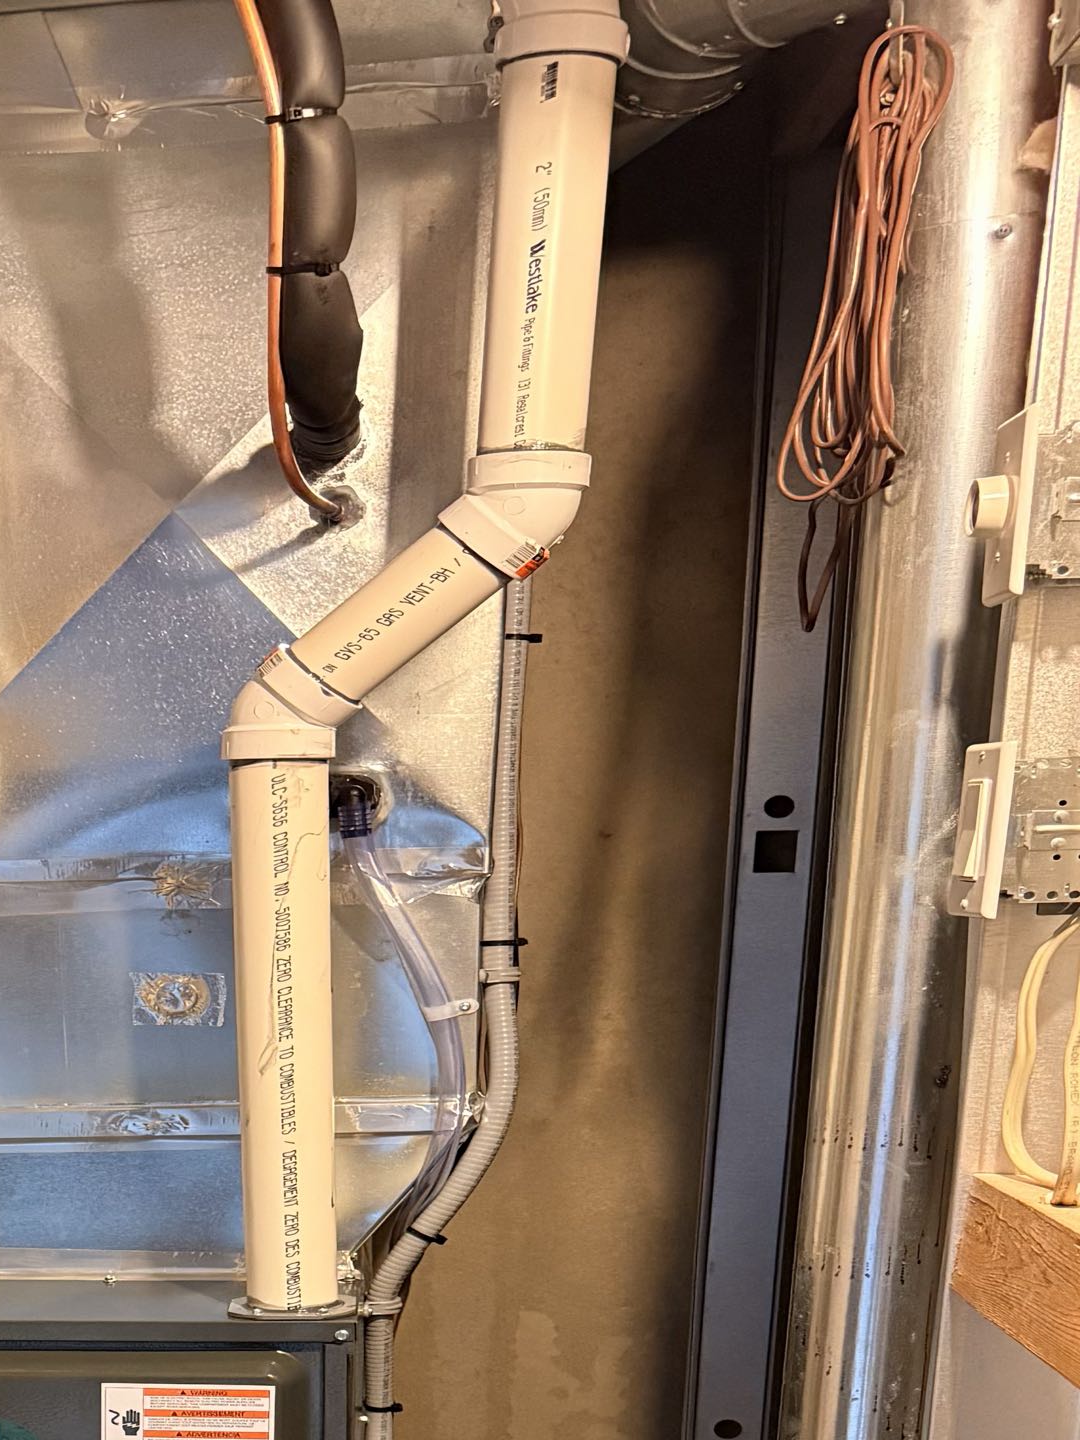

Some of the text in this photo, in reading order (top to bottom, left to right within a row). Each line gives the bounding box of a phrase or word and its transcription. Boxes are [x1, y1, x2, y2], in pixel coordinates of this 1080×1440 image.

[525, 187, 551, 314] (50mm) Westlake
[334, 567, 456, 661] GVS-65 GAS VENT-BH
[270, 772, 288, 827] ULC-S636
[273, 831, 289, 879] CONTROL
[274, 906, 292, 952] 5007586
[276, 955, 292, 983] ZERO
[277, 986, 294, 1043] CLEARANCE
[279, 1045, 294, 1060] TO
[279, 1062, 296, 1136] COMBUSTIBLES
[282, 1149, 298, 1209] DEGAGEMENT
[284, 1211, 299, 1237] ZERO
[285, 1239, 300, 1258] DES
